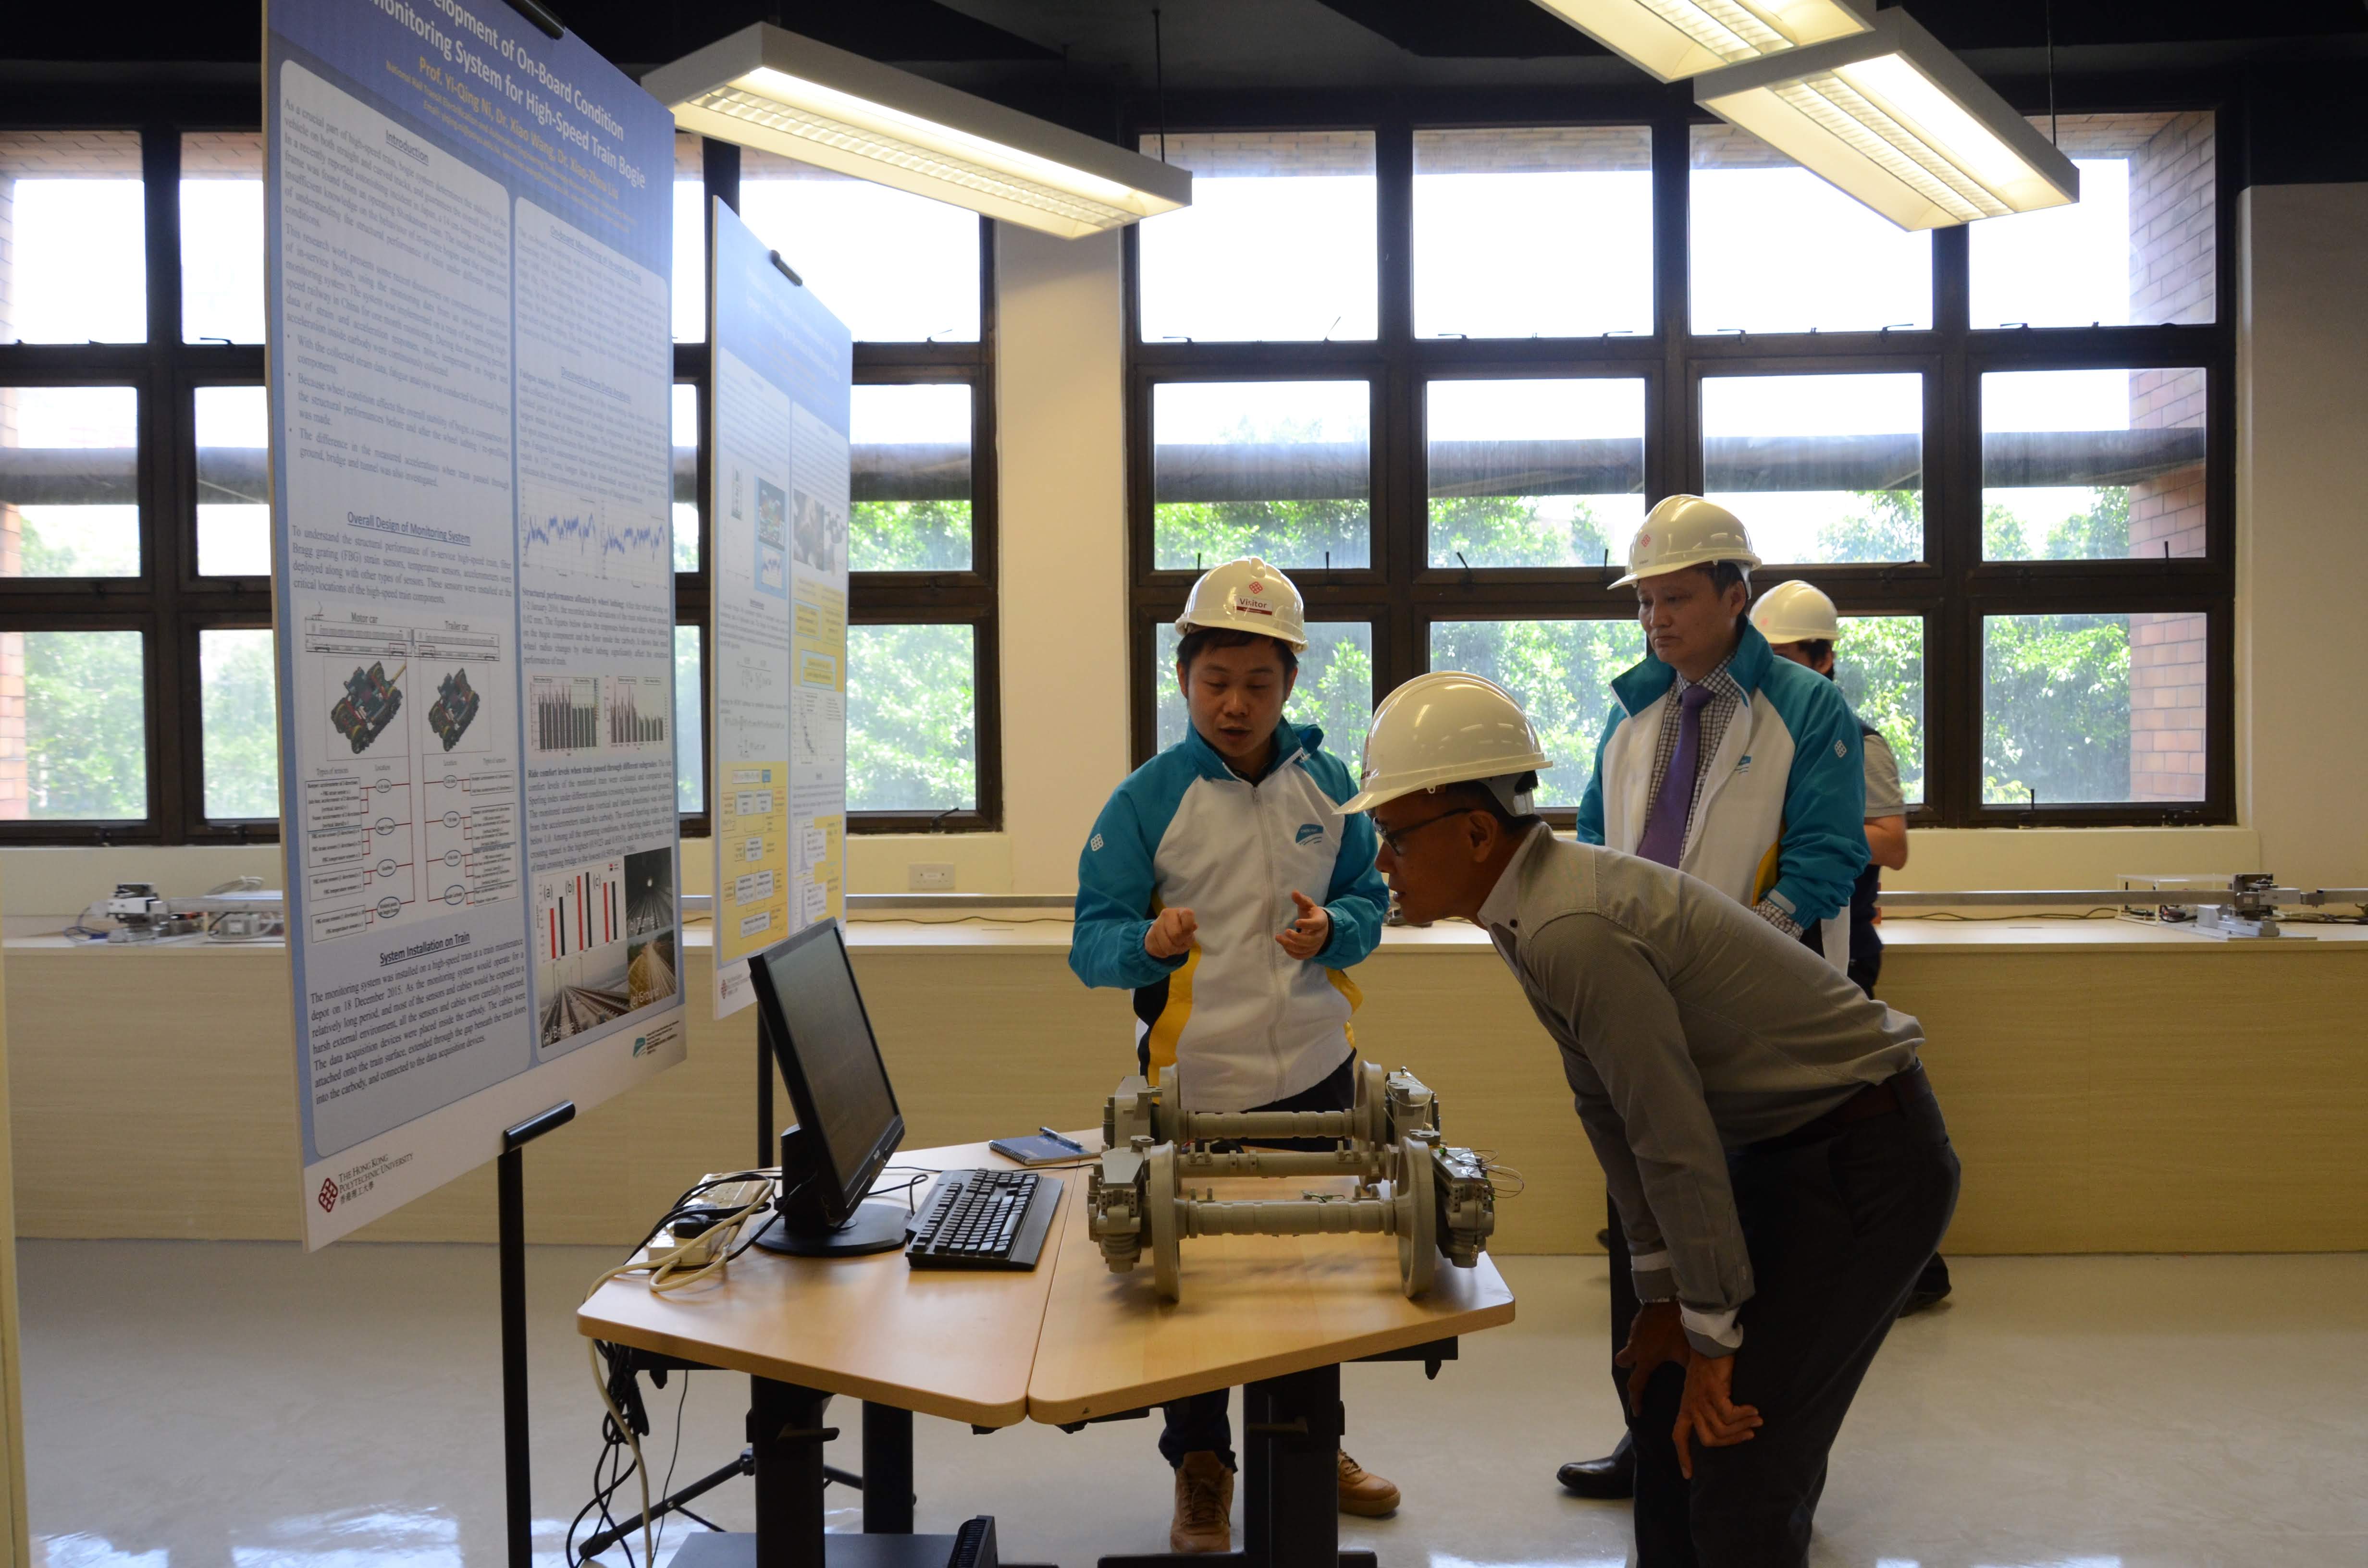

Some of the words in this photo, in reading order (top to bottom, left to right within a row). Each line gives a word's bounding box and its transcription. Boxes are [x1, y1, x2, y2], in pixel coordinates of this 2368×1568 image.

[429, 0, 498, 49] elopment
[502, 39, 515, 61] of
[517, 47, 571, 104] On-Board
[574, 88, 624, 141] Condition
[419, 55, 442, 85] Prof.
[445, 73, 480, 113] Yi-Qing
[481, 98, 494, 121] Ni,
[496, 107, 507, 128] Dr.
[510, 116, 529, 141] Xiao
[558, 147, 568, 168] Dr.
[456, 40, 502, 91] System
[506, 74, 524, 105] for
[527, 90, 589, 151] High-Speed
[592, 135, 617, 170] Train
[619, 156, 645, 189] Bogie
[385, 128, 429, 162] Introduction
[346, 510, 375, 527] Overall
[375, 515, 400, 532] Design
[400, 521, 408, 532] of
[409, 522, 447, 541] Monitoring
[448, 529, 471, 543] System
[351, 612, 368, 622] Motor
[1240, 598, 1267, 609] Visitor
[543, 884, 553, 900] (a)
[566, 880, 574, 896] (b)
[593, 872, 601, 890] (c)
[380, 950, 405, 965] System
[406, 939, 444, 956] Installation
[444, 938, 454, 946] on
[455, 931, 470, 943] Train
[311, 992, 323, 1004] The
[324, 983, 359, 1000] monitoring
[360, 978, 382, 992] system
[382, 974, 394, 983] was
[395, 965, 419, 980] installed
[432, 953, 460, 970] high-speed
[460, 950, 473, 961] train
[311, 1007, 330, 1021] depot
[332, 1005, 341, 1014] on
[344, 999, 352, 1011] 18
[354, 991, 385, 1007] December
[386, 985, 403, 998] 2015.
[405, 982, 414, 992] As
[415, 979, 425, 989] the
[427, 971, 456, 986] monitoring
[311, 1020, 342, 1037] relatively
[343, 1017, 358, 1028] long
[358, 1007, 380, 1025] period,
[381, 1003, 393, 1016] and
[392, 1000, 407, 1012] most
[407, 996, 415, 1007] of
[415, 994, 424, 1004] the
[425, 990, 445, 1002] sensors
[445, 984, 456, 995] and
[312, 1039, 331, 1054] harsh
[332, 1030, 358, 1048] external
[358, 1019, 398, 1039] environment,
[399, 1014, 407, 1026] all
[407, 1012, 418, 1022] the
[417, 1007, 438, 1019] sensors
[439, 1000, 450, 1012] and
[450, 997, 467, 1008] cables
[467, 993, 480, 1003] were
[481, 984, 502, 998] carefully
[502, 977, 524, 993] protected.
[314, 1058, 327, 1071] The
[329, 1054, 343, 1066] data
[345, 1042, 378, 1060] acquisition
[380, 1035, 401, 1048] devices
[403, 1029, 418, 1040] were
[419, 1019, 438, 1037] placed
[437, 1015, 455, 1028] inside
[455, 1011, 464, 1021] the
[465, 1004, 486, 1018] carbody.
[487, 1000, 497, 1010] The
[498, 995, 514, 1007] cables
[514, 992, 527, 1001] were
[338, 1171, 351, 1183] THE
[353, 1162, 371, 1176] HONG
[371, 1153, 389, 1168] KONG
[339, 1170, 380, 1194] POLYTECHNIC
[381, 1152, 413, 1174] UNIVERSITY
